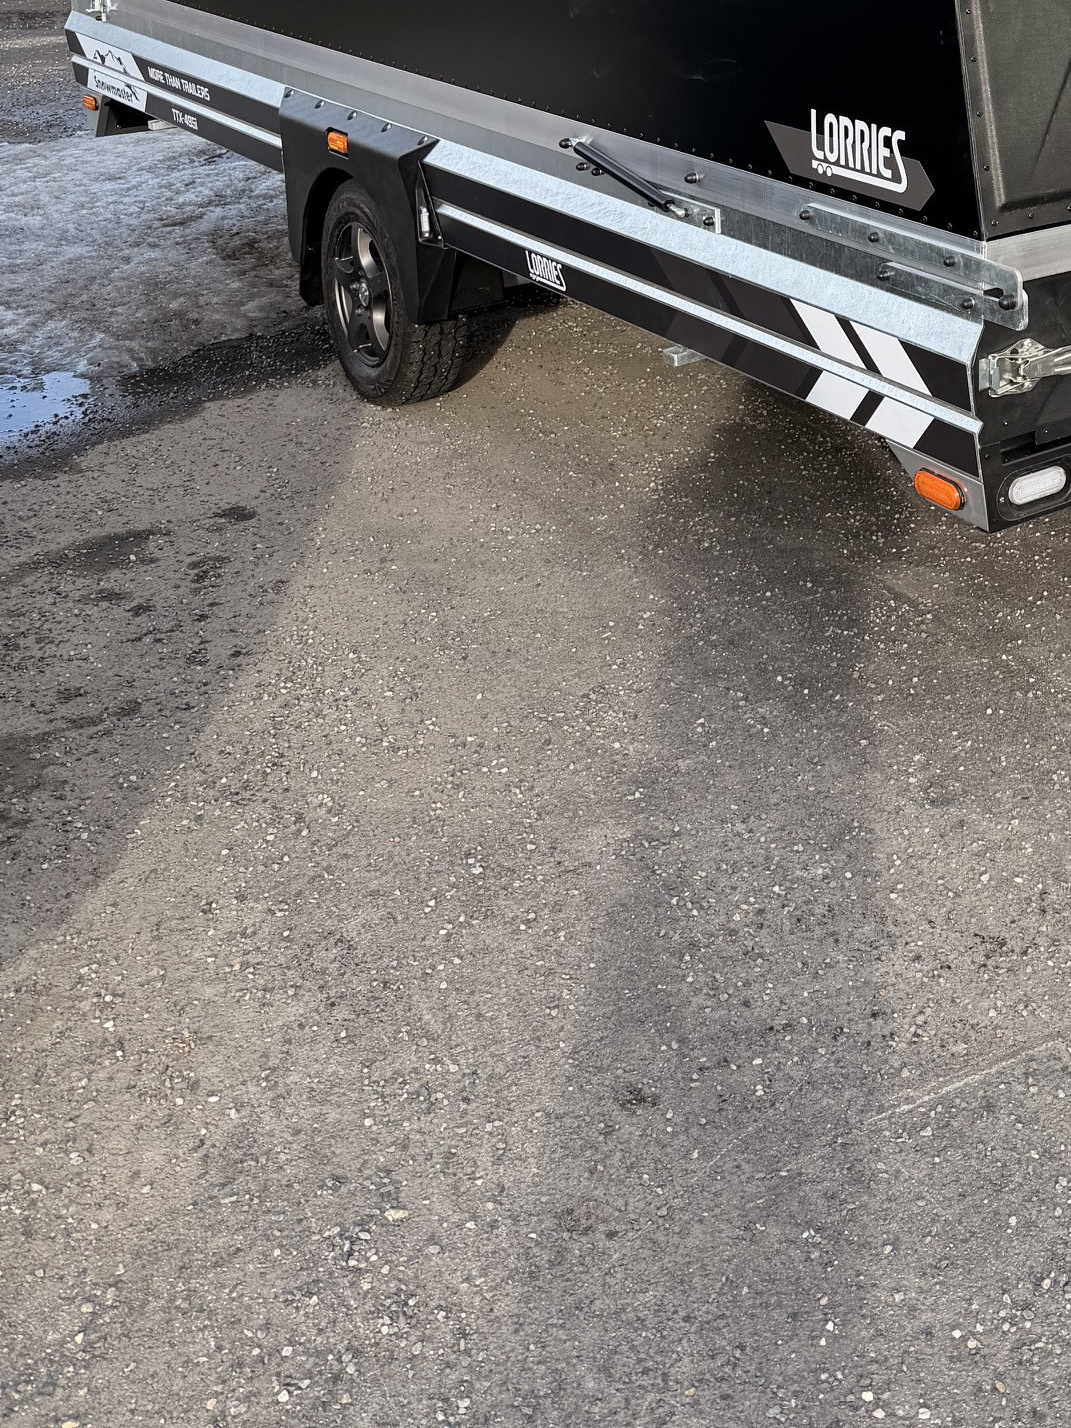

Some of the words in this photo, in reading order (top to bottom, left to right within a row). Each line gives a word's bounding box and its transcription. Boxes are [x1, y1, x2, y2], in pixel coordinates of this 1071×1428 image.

[148, 66, 164, 83] MORE
[164, 73, 181, 91] THAN
[181, 80, 210, 101] TRAILERS
[810, 108, 907, 193] LORRIES
[525, 250, 566, 291] LORRIES
